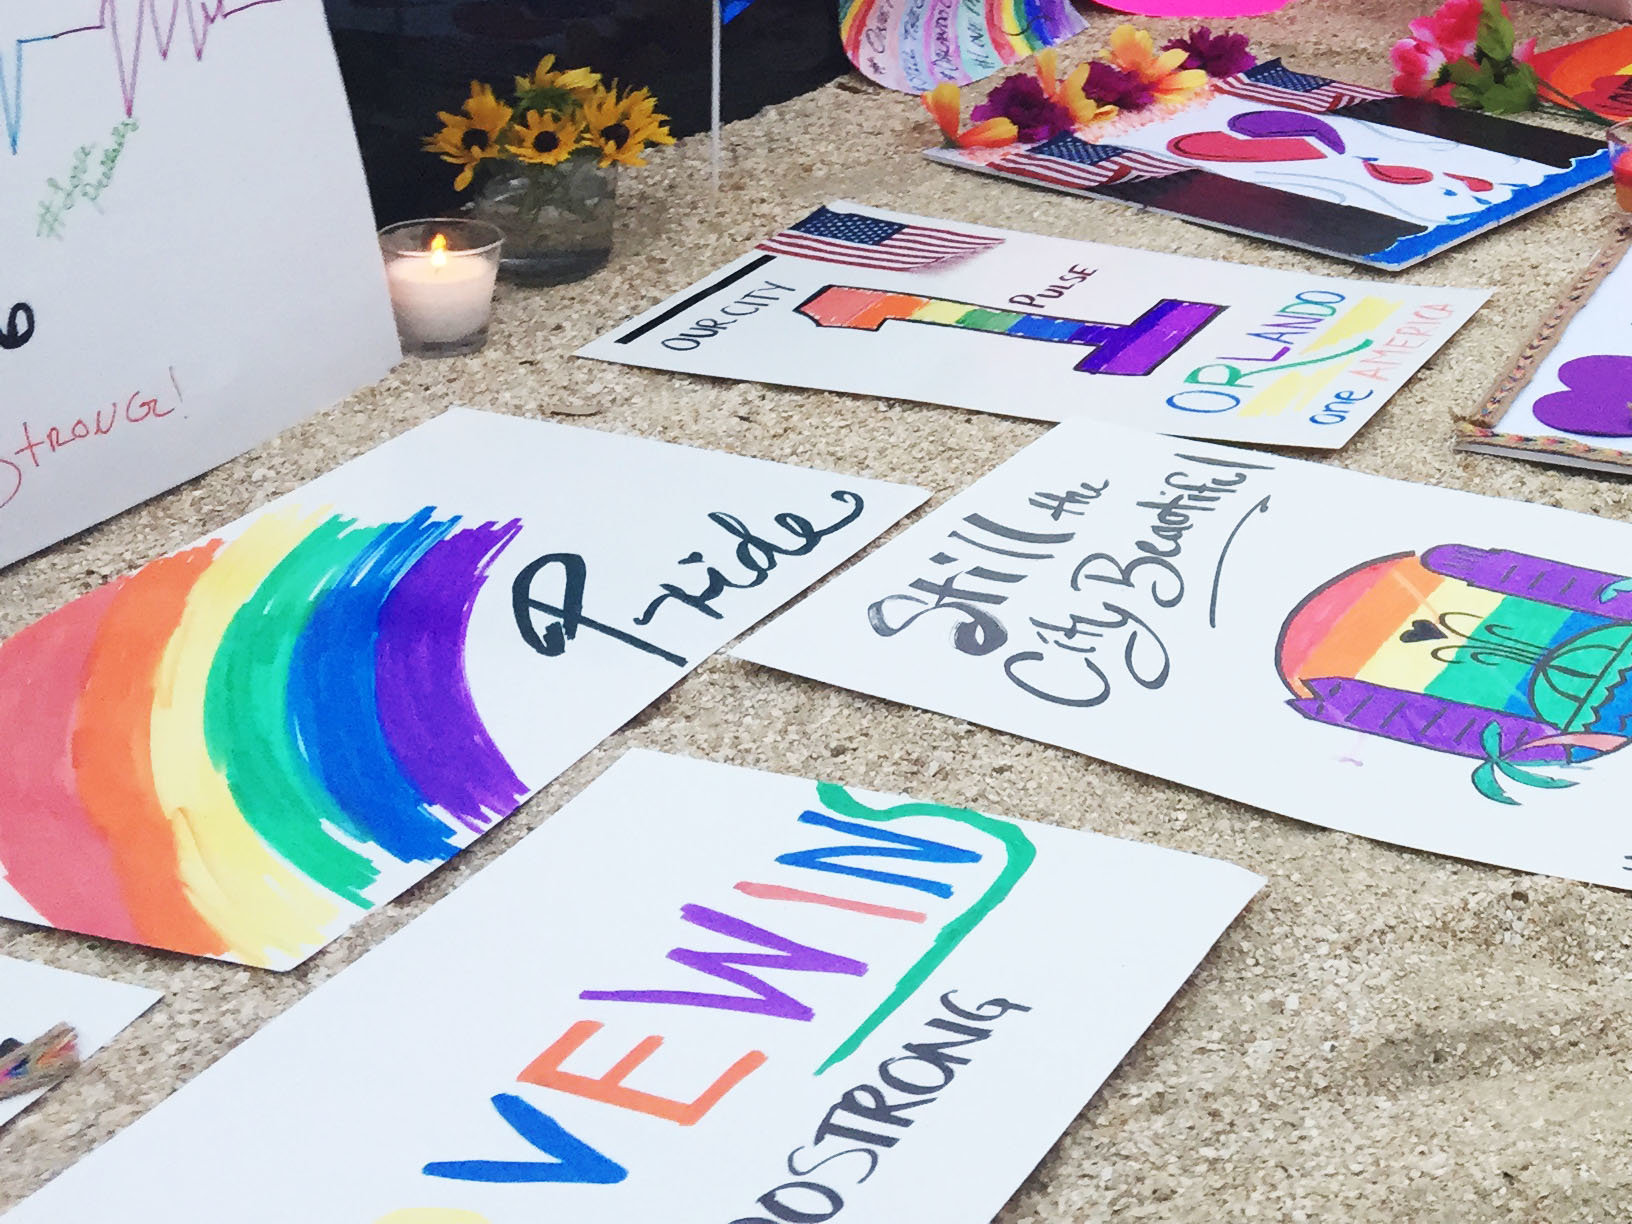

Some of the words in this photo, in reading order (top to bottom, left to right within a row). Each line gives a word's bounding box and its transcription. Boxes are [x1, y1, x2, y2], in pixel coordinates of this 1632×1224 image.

[661, 318, 738, 351] OUR
[720, 281, 796, 318] CITY
[1166, 290, 1346, 413] ORLANDO
[512, 489, 864, 667] Pride
[867, 512, 1076, 656] Still
[1071, 453, 1276, 609] Beautiful
[1004, 602, 1170, 708] City
